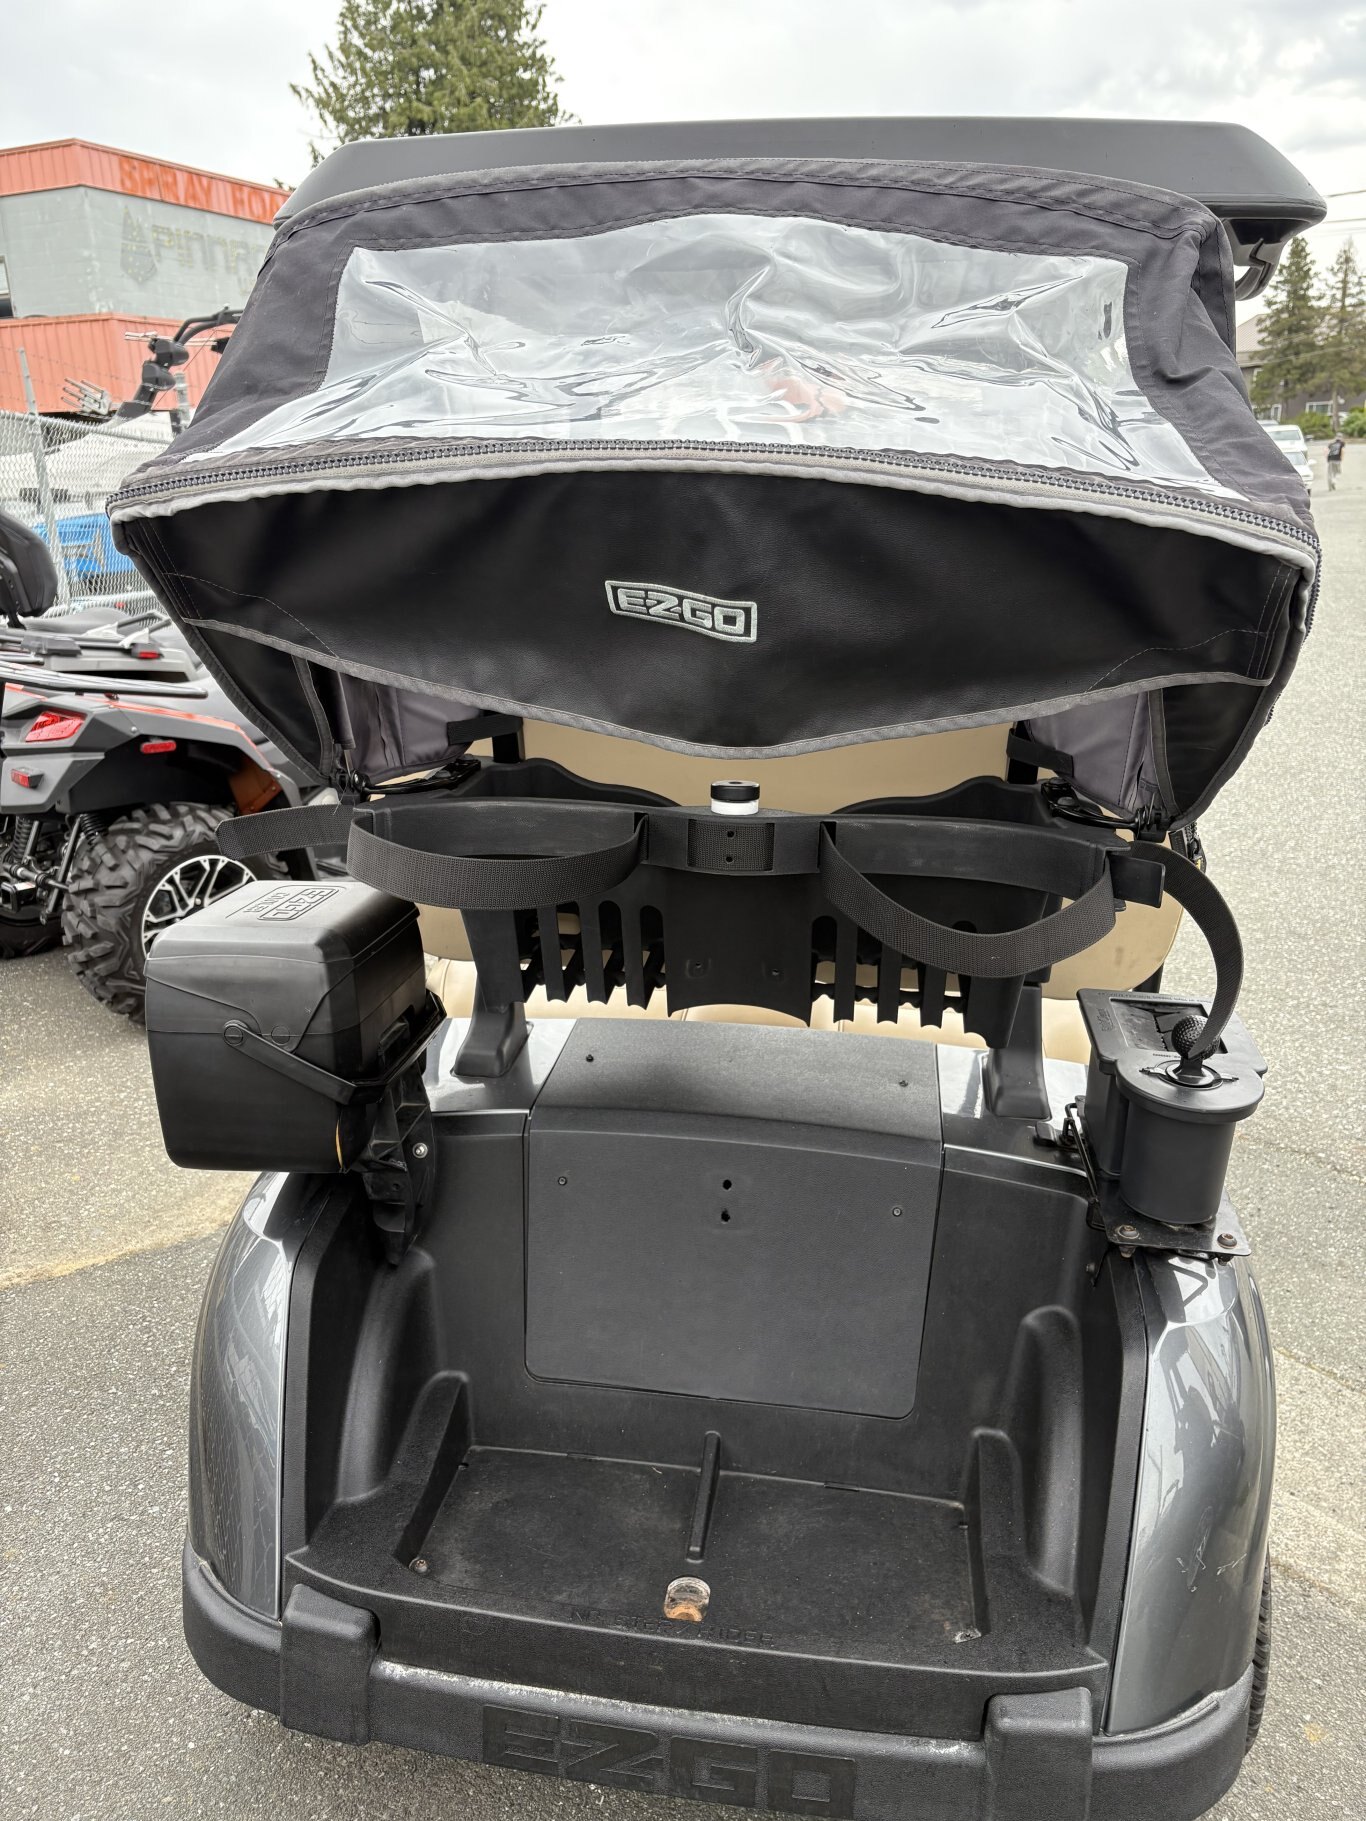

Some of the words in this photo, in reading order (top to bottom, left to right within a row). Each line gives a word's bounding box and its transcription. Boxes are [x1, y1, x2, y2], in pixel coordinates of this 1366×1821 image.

[119, 156, 212, 209] SPRAY
[616, 587, 746, 635] EZGO
[483, 1705, 855, 1819] EZGO
